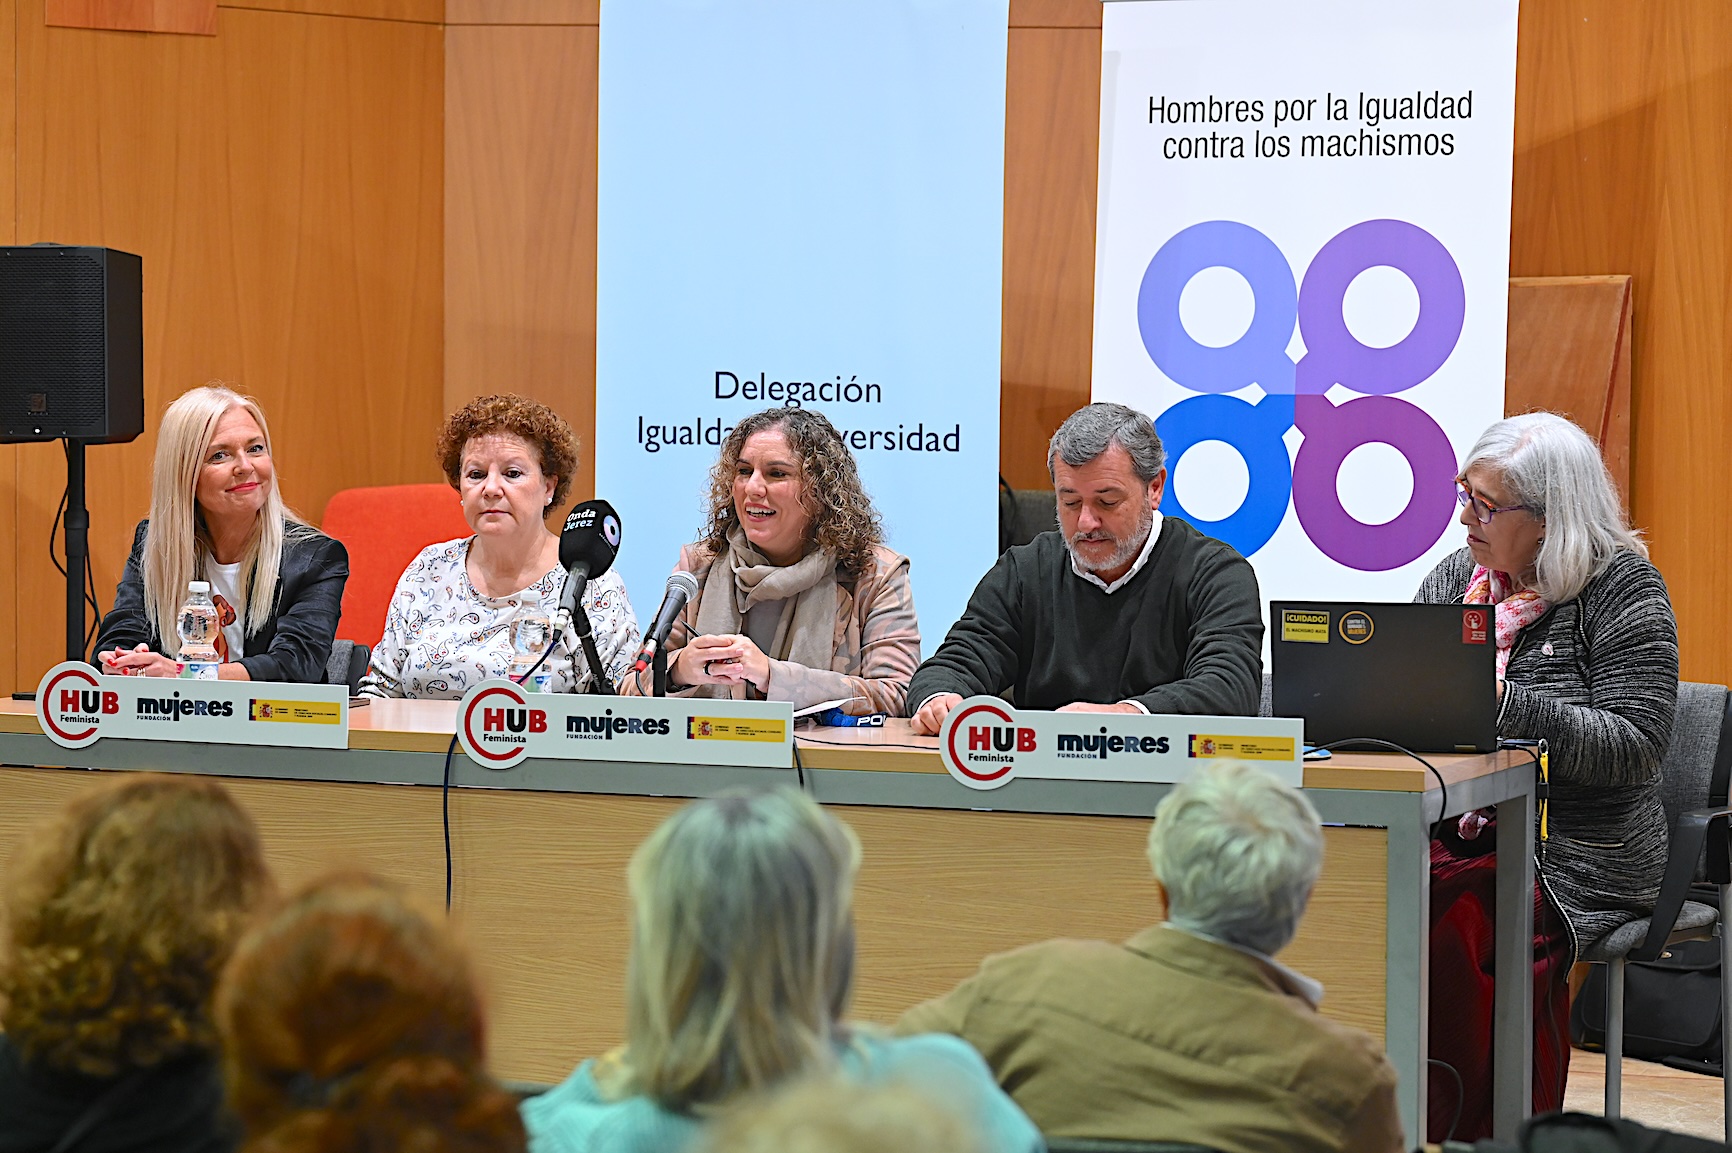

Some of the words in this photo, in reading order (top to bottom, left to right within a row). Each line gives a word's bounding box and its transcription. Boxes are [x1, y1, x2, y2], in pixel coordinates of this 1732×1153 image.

[1149, 95, 1264, 124] Hombres
[1274, 98, 1317, 128] por
[1327, 92, 1349, 121] la
[1359, 90, 1473, 127] Igualdad
[1163, 131, 1245, 159] contra
[1255, 129, 1291, 158] los
[1301, 128, 1455, 157] machismos
[714, 370, 882, 408] Delegación
[637, 415, 734, 453] Iguald
[842, 422, 960, 453] ersidad
[1286, 613, 1327, 624] ¡CUIDADO!
[60, 689, 120, 715] HUB
[60, 714, 100, 724] Feminista
[483, 707, 548, 733] HUB
[856, 714, 887, 727] PO
[483, 733, 527, 743] Feminista
[968, 726, 1037, 753] HUB
[968, 752, 1014, 763] Feminista
[1057, 752, 1098, 760] FUNDACIÓN
